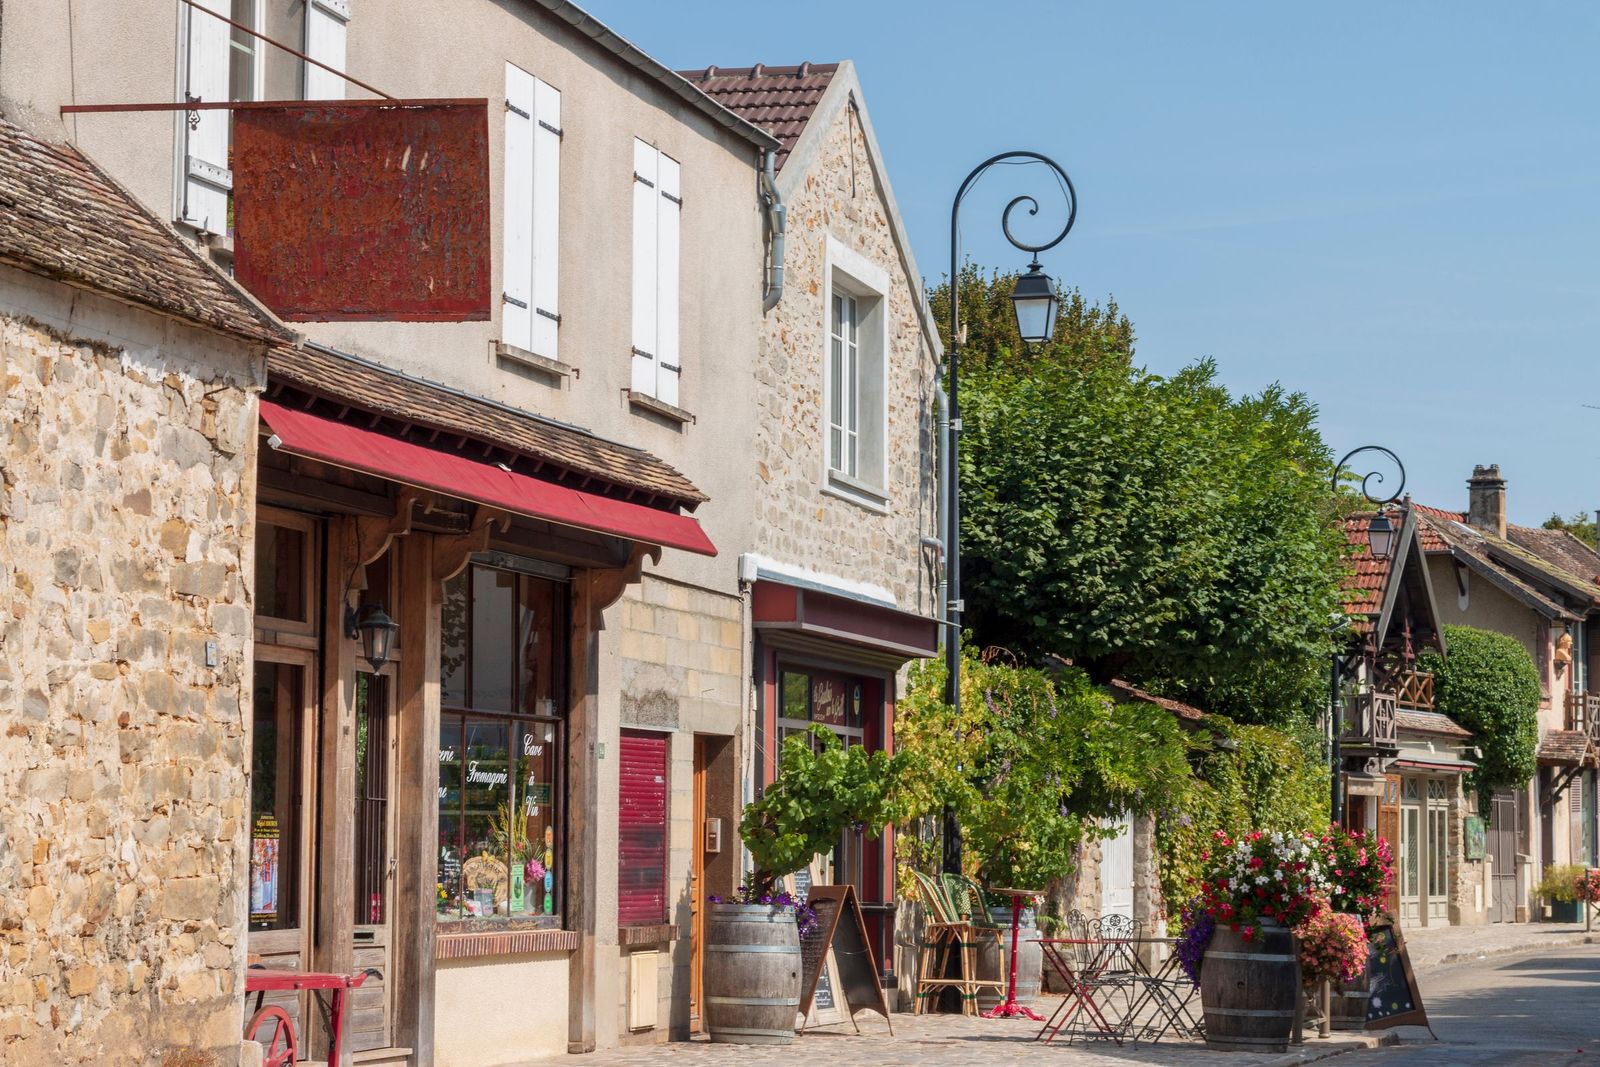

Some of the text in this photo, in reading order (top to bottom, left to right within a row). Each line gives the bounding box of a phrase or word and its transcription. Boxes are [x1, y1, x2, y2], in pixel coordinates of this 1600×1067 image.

[524, 734, 542, 756] Cave
[467, 761, 508, 790] Fromagerie
[528, 770, 535, 786] à
[526, 796, 539, 816] Vin
